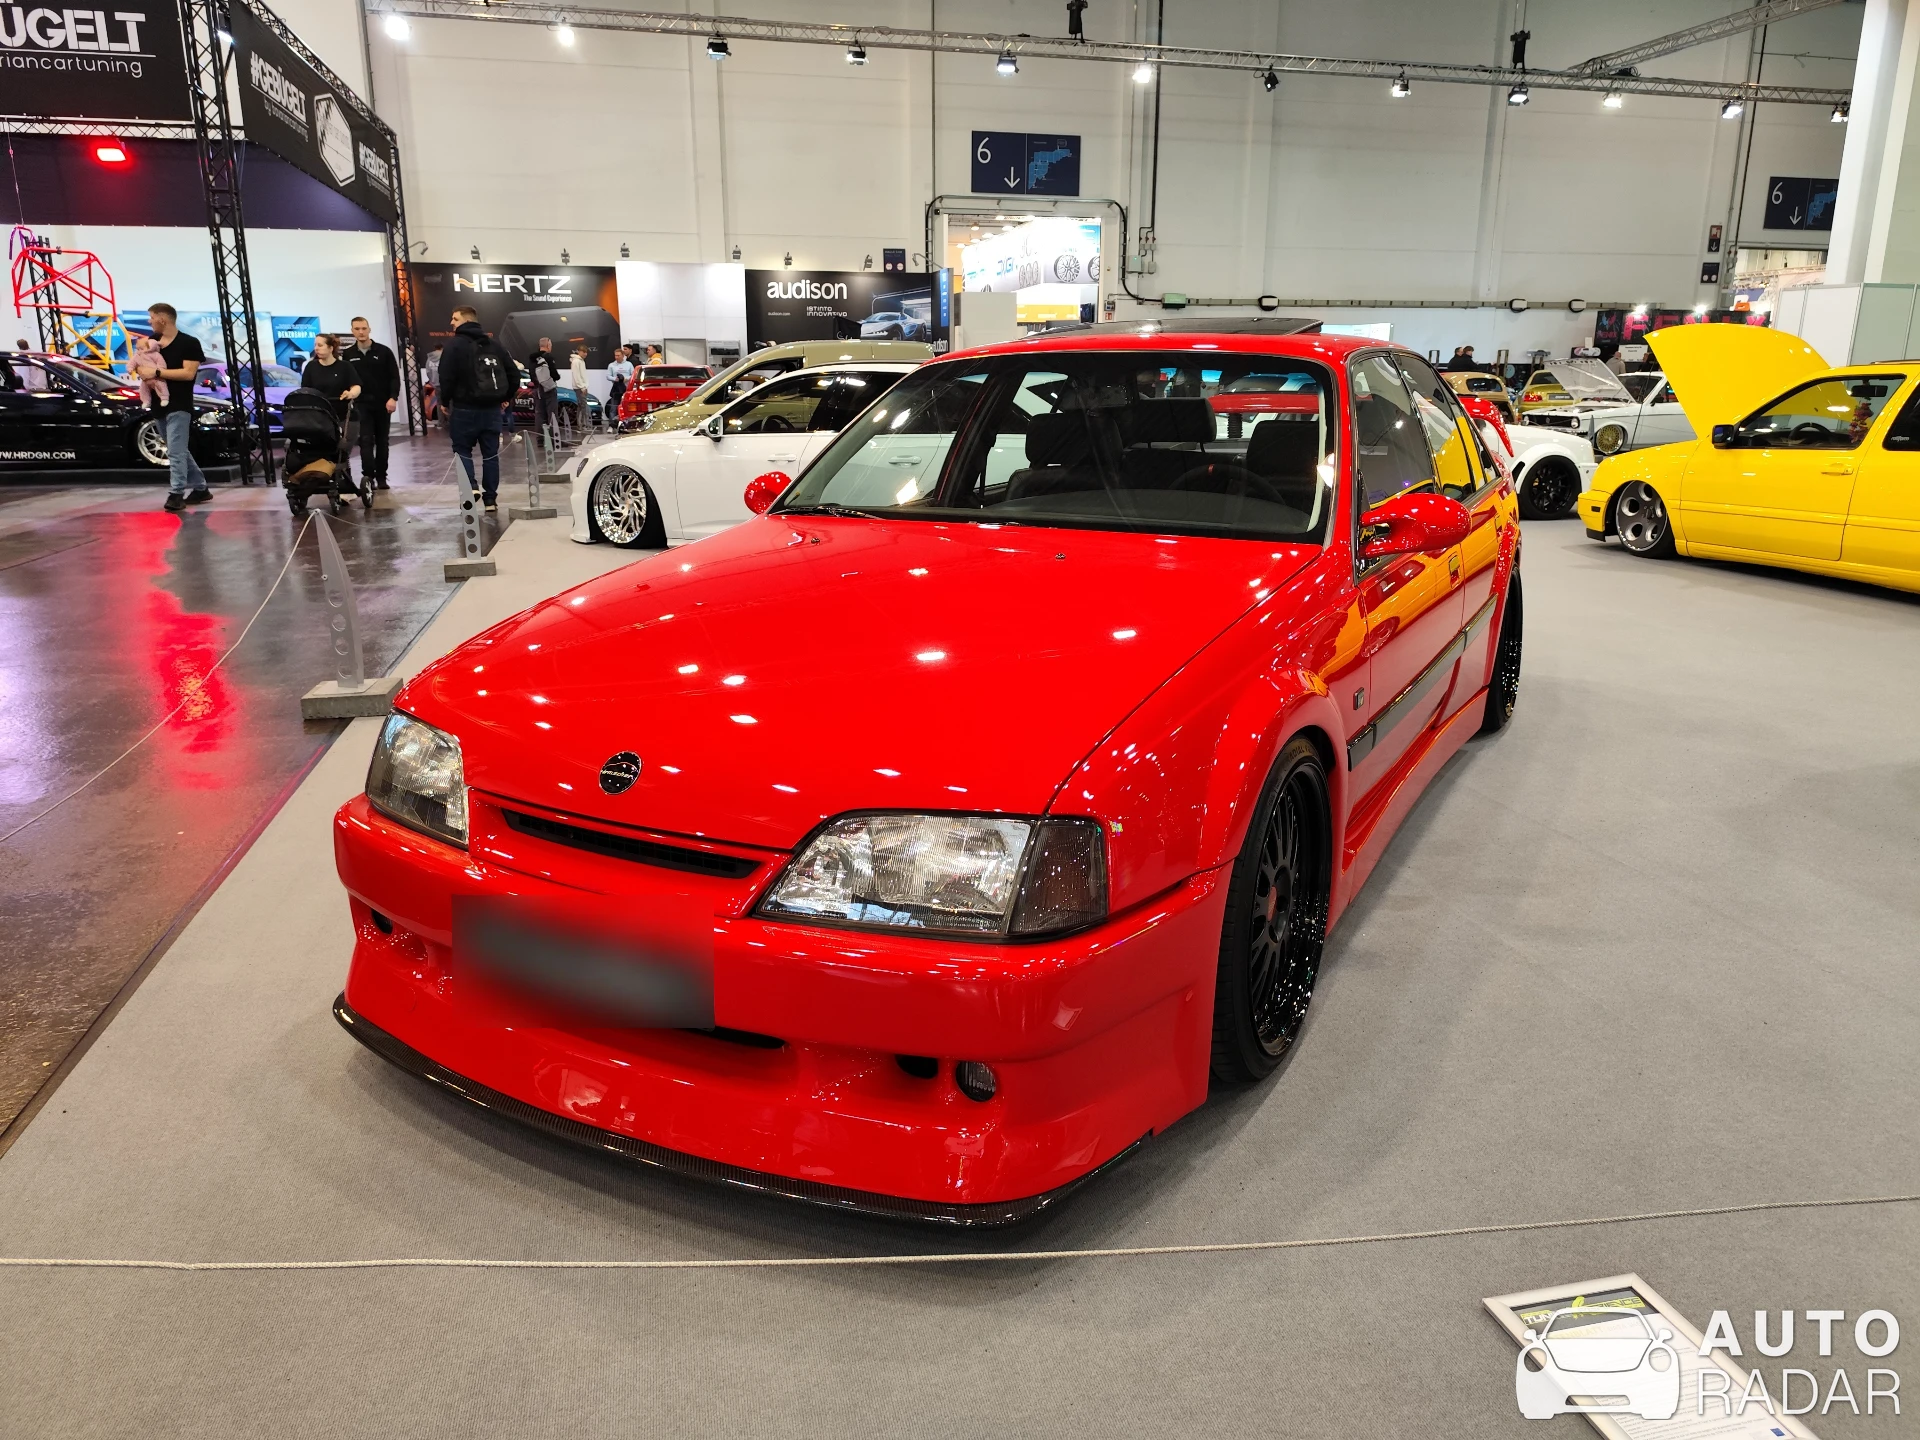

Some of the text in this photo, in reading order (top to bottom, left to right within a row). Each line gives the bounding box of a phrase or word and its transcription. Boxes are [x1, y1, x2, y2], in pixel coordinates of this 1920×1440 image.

[977, 137, 992, 164] 6
[1771, 181, 1783, 205] 6
[453, 273, 572, 294] HERTZ
[767, 279, 848, 300] audison
[523, 294, 573, 303] The Sound Experience
[0, 451, 76, 460] W.HRDGN.COM
